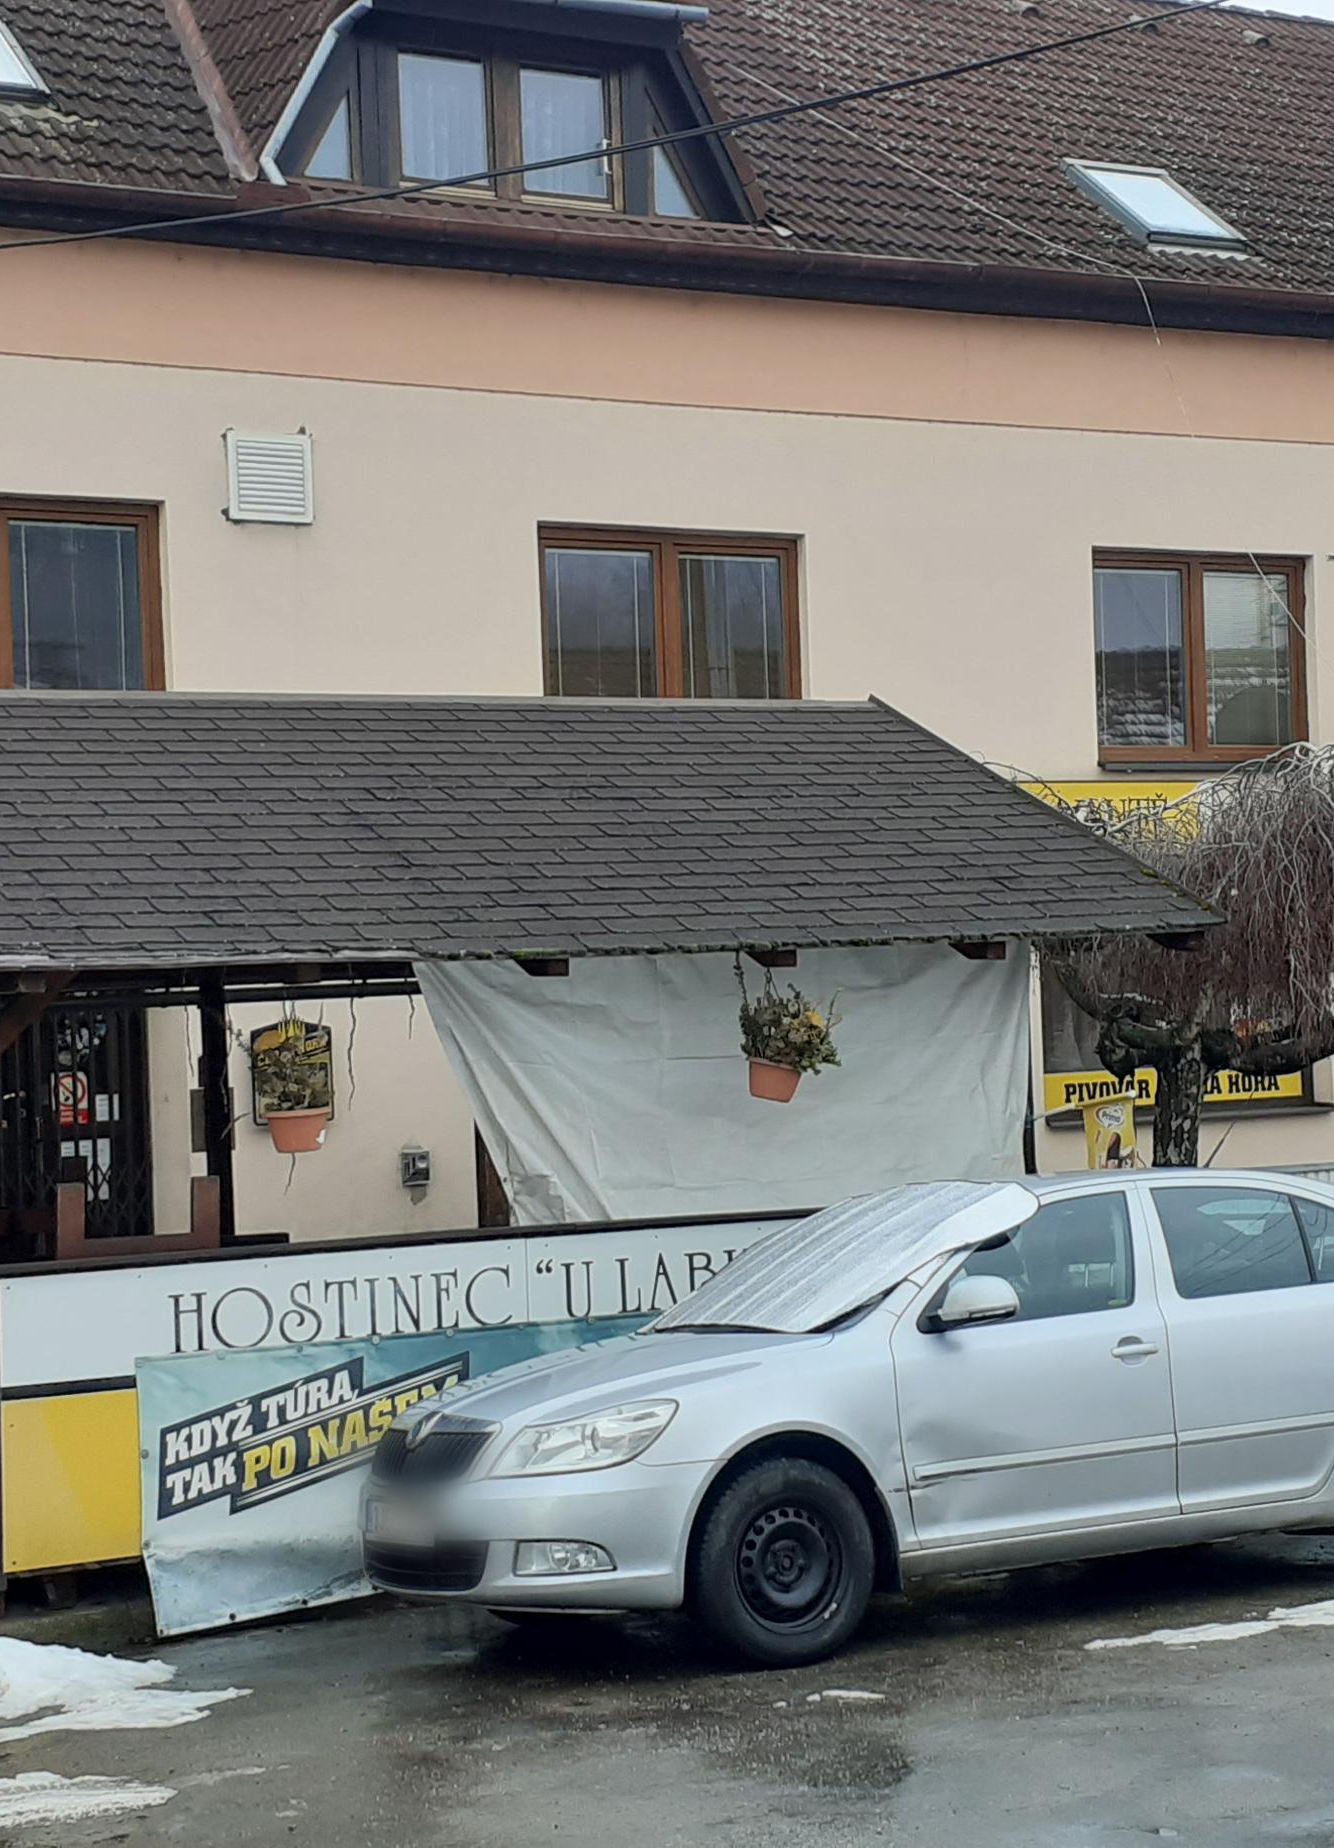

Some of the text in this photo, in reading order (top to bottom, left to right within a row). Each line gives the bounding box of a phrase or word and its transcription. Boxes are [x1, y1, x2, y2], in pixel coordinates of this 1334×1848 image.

[1064, 1079, 1151, 1103] PIVOVAR
[1227, 1073, 1280, 1094] HORA
[167, 1264, 514, 1355] HOSTINEC
[165, 1368, 360, 1467] KDYŽ TÚRA,
[166, 1450, 238, 1506] TAK
[241, 1435, 297, 1492] PO
